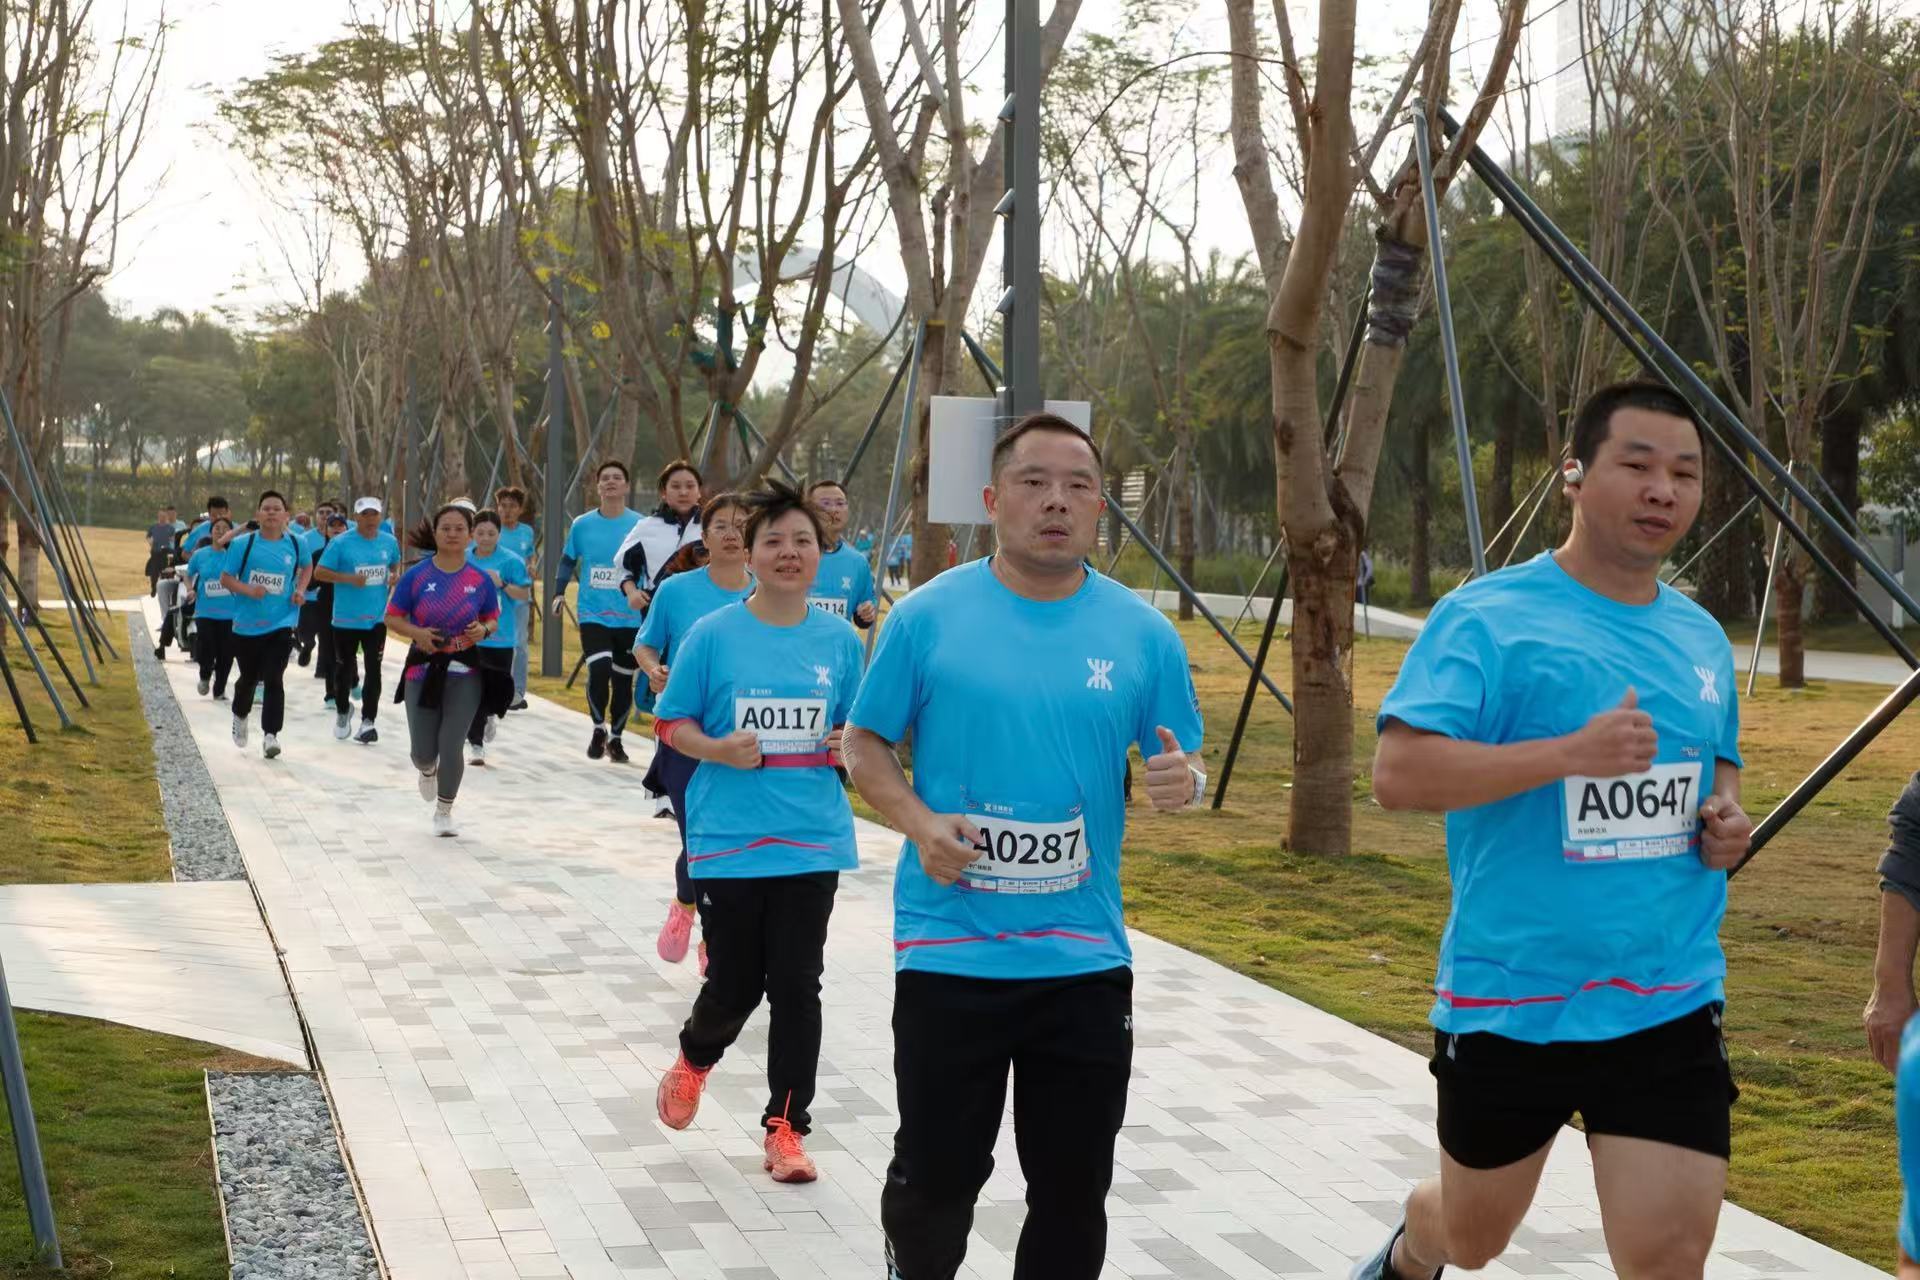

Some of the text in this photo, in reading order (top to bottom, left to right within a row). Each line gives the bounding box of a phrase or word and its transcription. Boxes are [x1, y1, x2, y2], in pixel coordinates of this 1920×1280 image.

[251, 574, 283, 587] A0648
[593, 570, 614, 581] A02
[741, 707, 821, 730] A0117
[1578, 777, 1692, 822] A0647
[973, 827, 1081, 864] A0287
